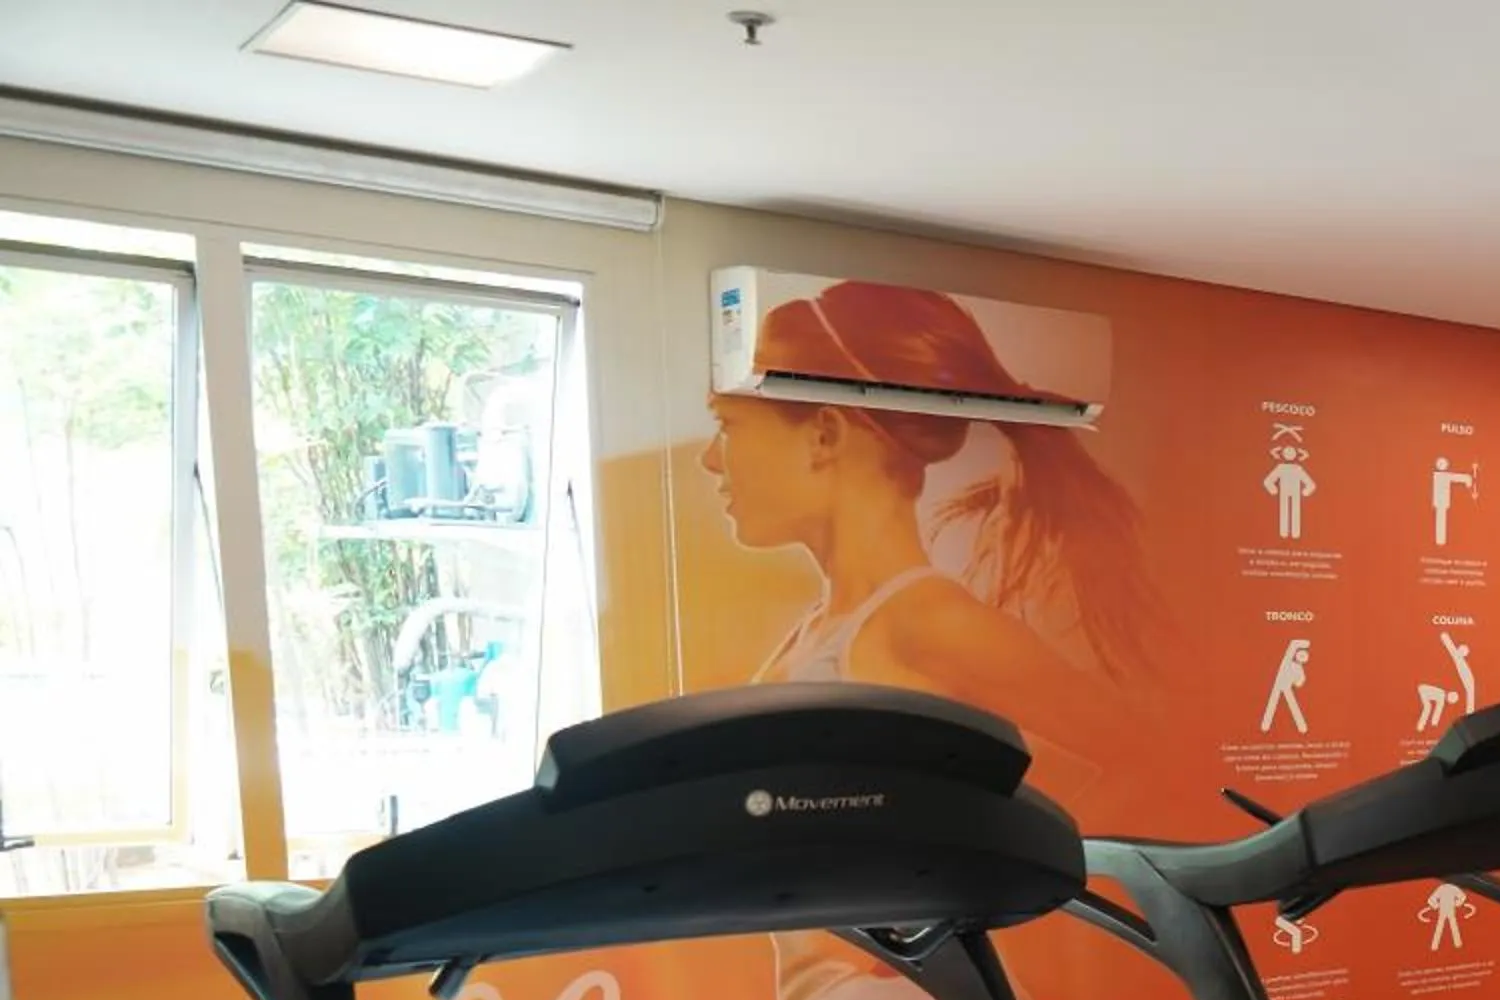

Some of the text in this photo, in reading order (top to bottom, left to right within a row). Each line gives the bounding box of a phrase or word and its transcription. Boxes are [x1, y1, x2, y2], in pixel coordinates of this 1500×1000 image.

[1440, 422, 1475, 436] PULSO
[1265, 610, 1315, 622] TRONCO
[1431, 614, 1475, 626] COLUNA
[774, 793, 886, 811] Movement
